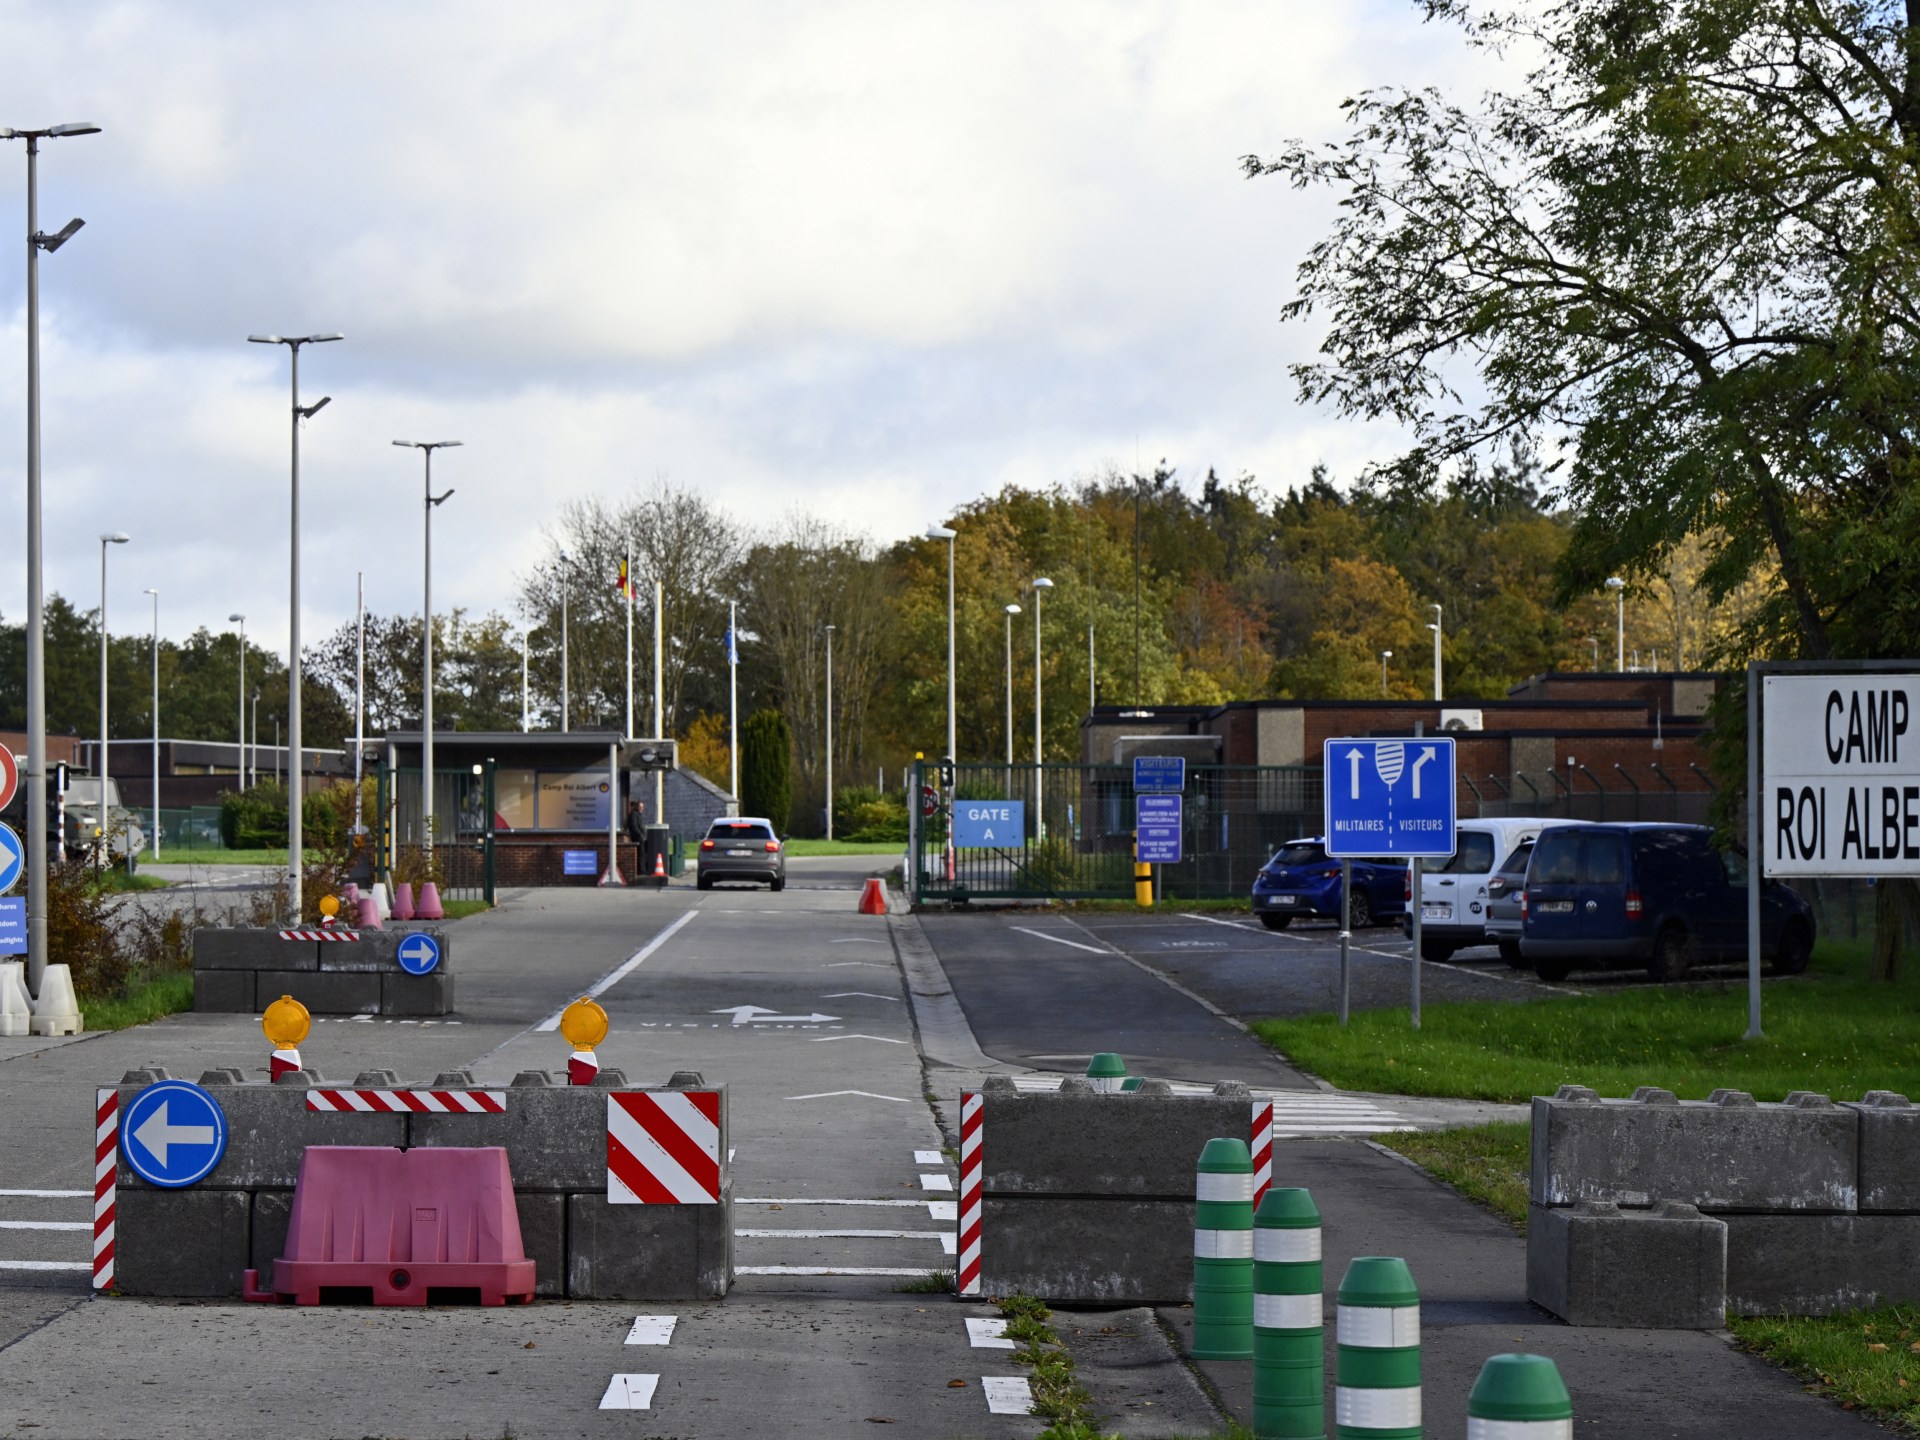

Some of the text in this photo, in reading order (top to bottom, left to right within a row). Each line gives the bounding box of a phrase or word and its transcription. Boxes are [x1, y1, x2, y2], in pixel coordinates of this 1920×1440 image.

[1825, 689, 1909, 765] CAMP
[968, 808, 1010, 821] GATE
[1335, 819, 1384, 832] MILITAIRES
[1399, 819, 1443, 831] VISITEURS
[1777, 786, 1920, 861] ROI ALBE
[983, 828, 994, 840] A
